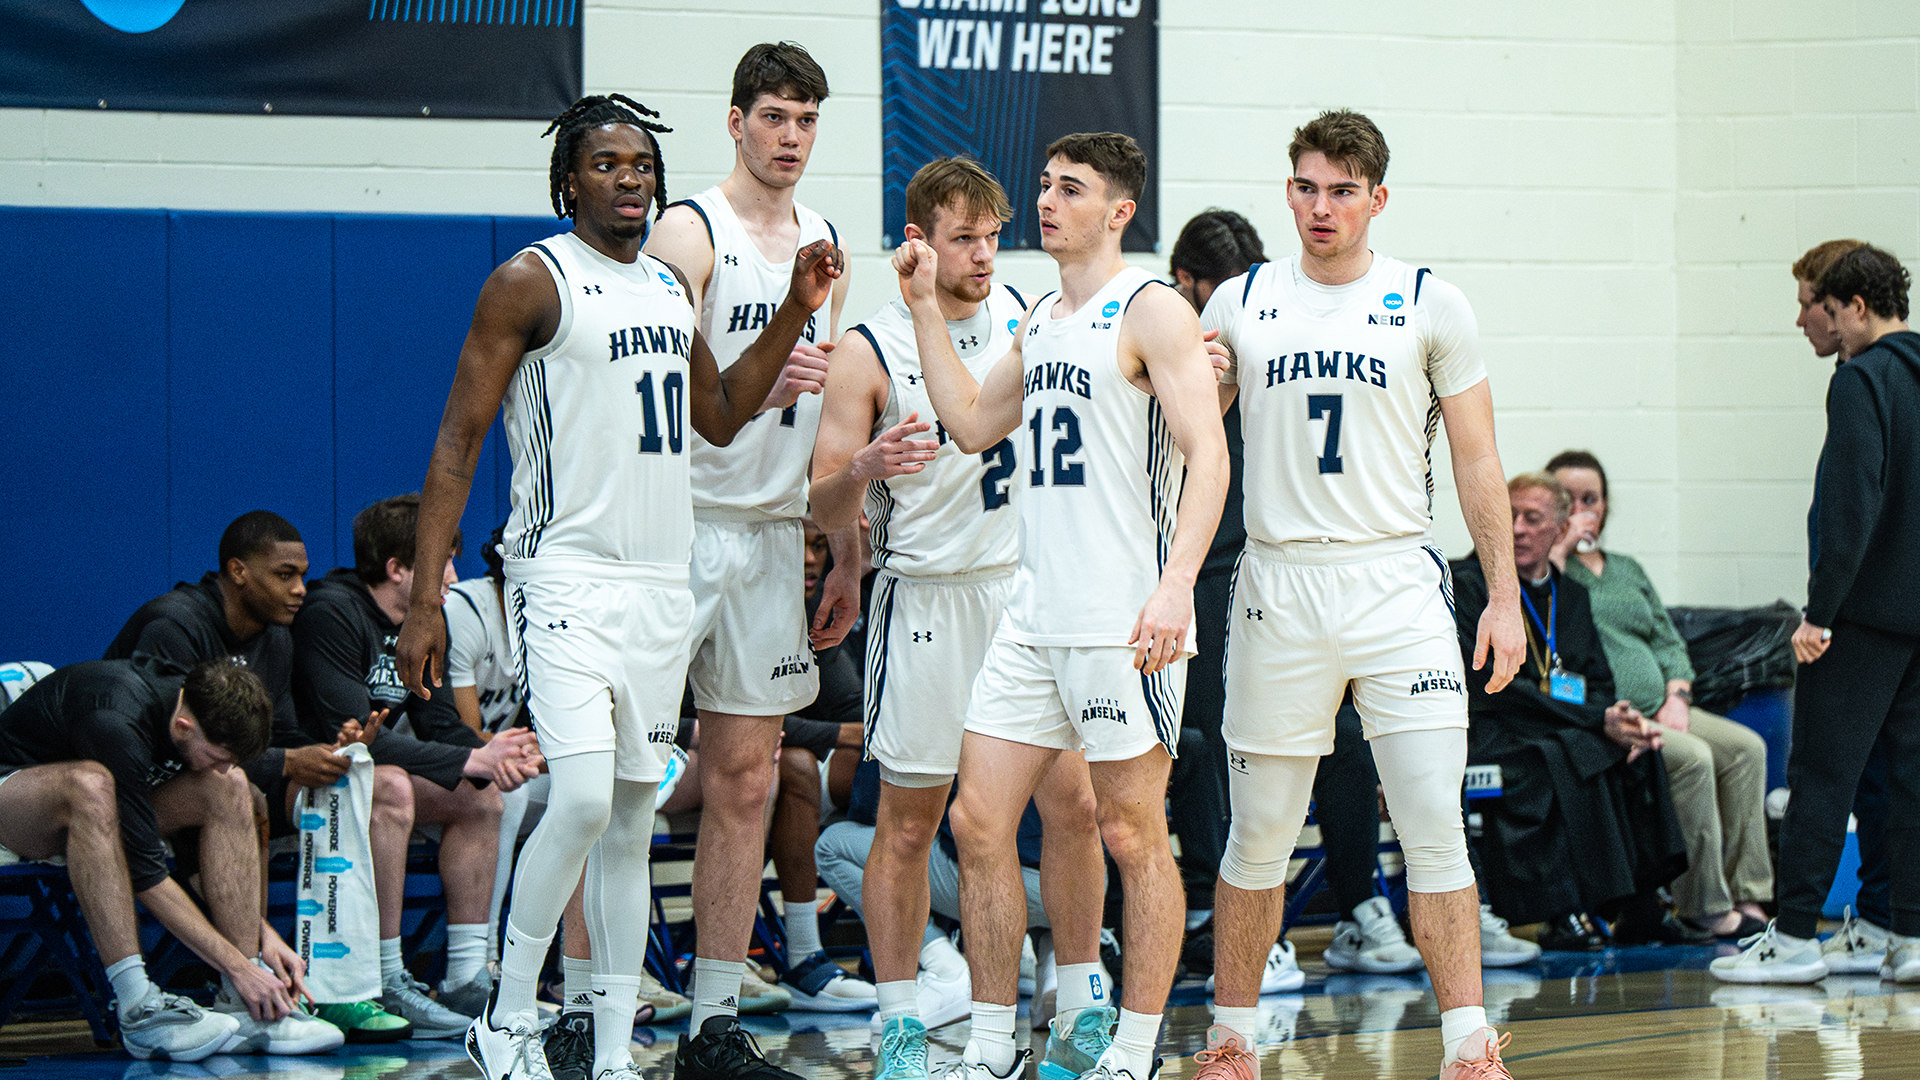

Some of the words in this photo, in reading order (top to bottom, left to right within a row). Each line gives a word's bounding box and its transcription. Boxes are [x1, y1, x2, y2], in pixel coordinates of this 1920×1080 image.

[917, 18, 1003, 71] WIN
[608, 325, 690, 363] HAWKS
[726, 302, 816, 343] HAS
[1368, 314, 1405, 326] NE10
[1024, 361, 1091, 400] HAWKS
[1265, 350, 1387, 389] HAWKS
[635, 370, 684, 456] 10
[1306, 393, 1344, 475] 7
[1028, 405, 1088, 488] 12
[980, 436, 1018, 513] 2
[1410, 678, 1463, 696] ANSELM
[1081, 706, 1128, 725] ANSELM
[329, 793, 339, 853] POWERADE
[303, 832, 314, 890] POWERADE
[328, 875, 338, 934] POWERADE
